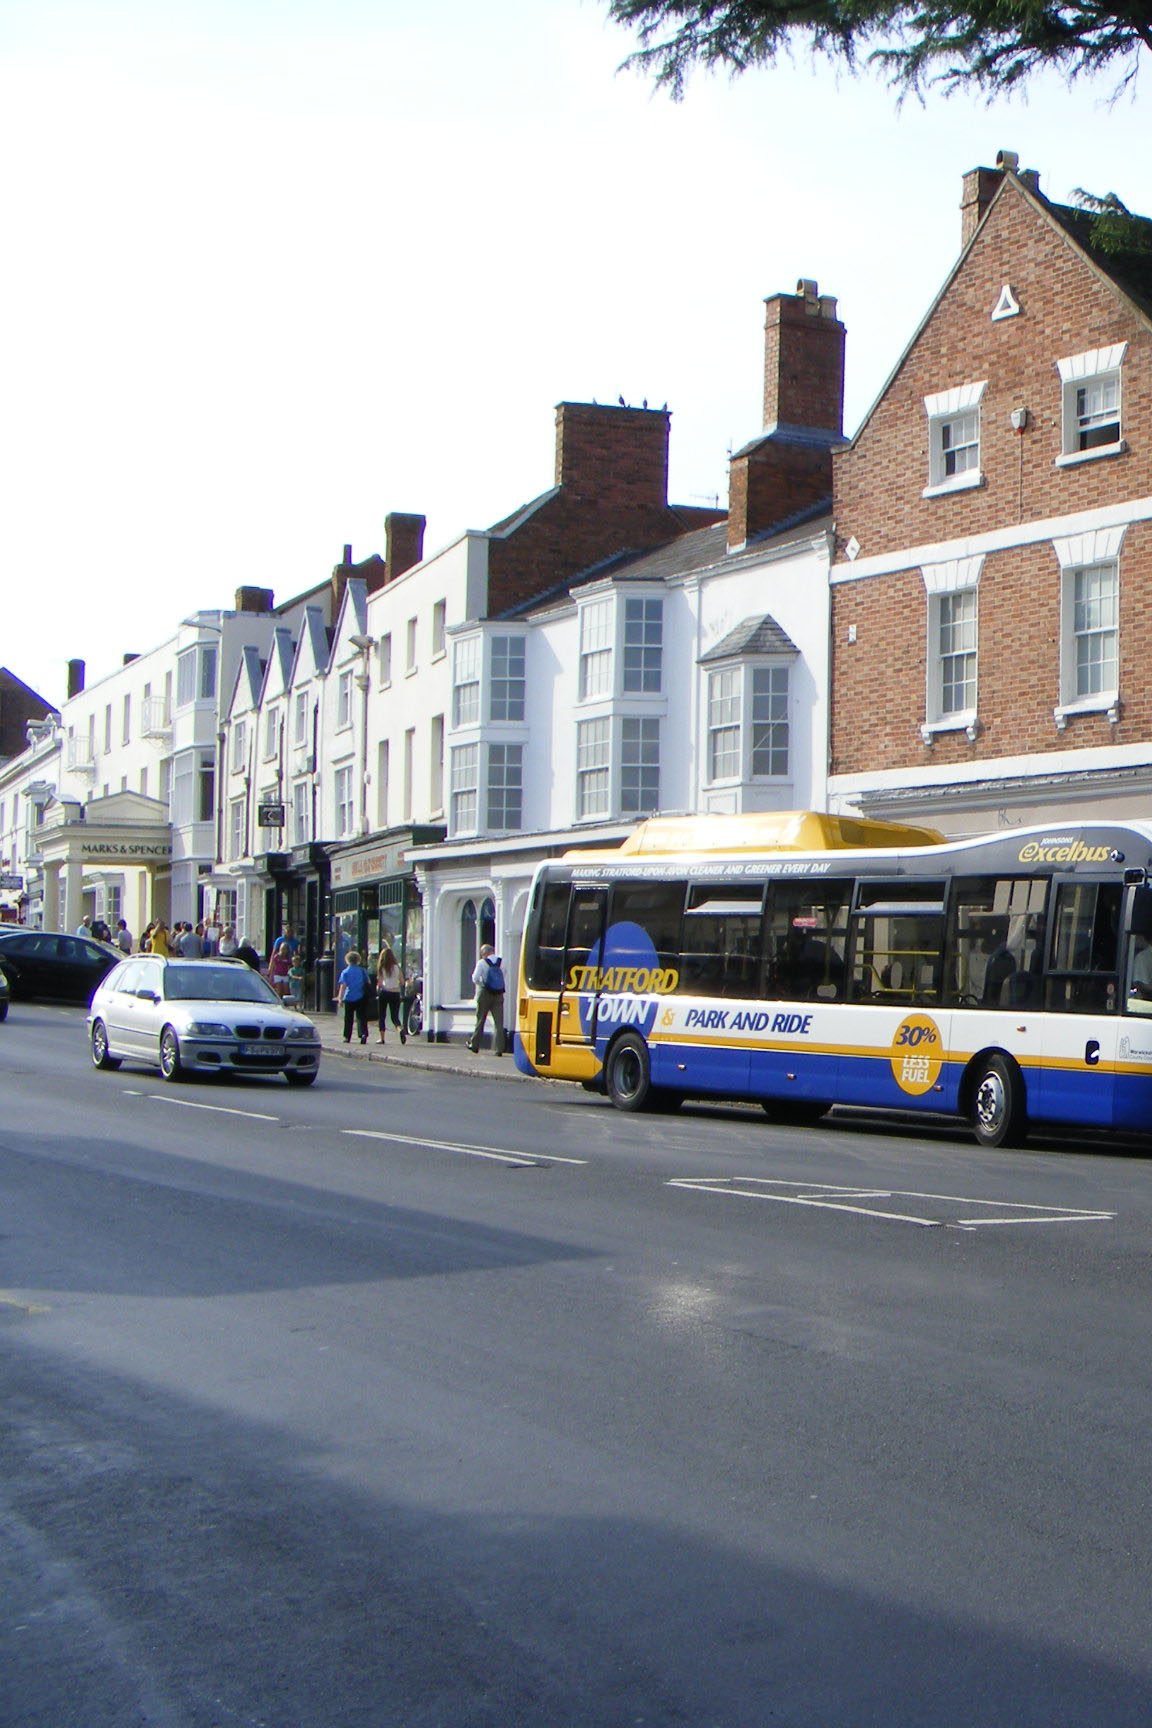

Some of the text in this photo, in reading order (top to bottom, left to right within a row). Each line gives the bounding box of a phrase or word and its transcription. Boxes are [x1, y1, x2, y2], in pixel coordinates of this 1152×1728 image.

[82, 843, 172, 855] MARKS & SPENCER
[570, 867, 601, 877] MAKING
[689, 864, 725, 876] CLEANER
[724, 864, 743, 875] AND
[744, 863, 782, 874] GREENER
[782, 863, 810, 874] EVERY
[810, 862, 832, 873] DAY
[565, 964, 680, 994] STRATFORD
[585, 997, 814, 1035] TOWN & PARK AND RIDE
[895, 1025, 937, 1047] 30%
[902, 1054, 931, 1069] LESS
[901, 1068, 930, 1083] FUEL
